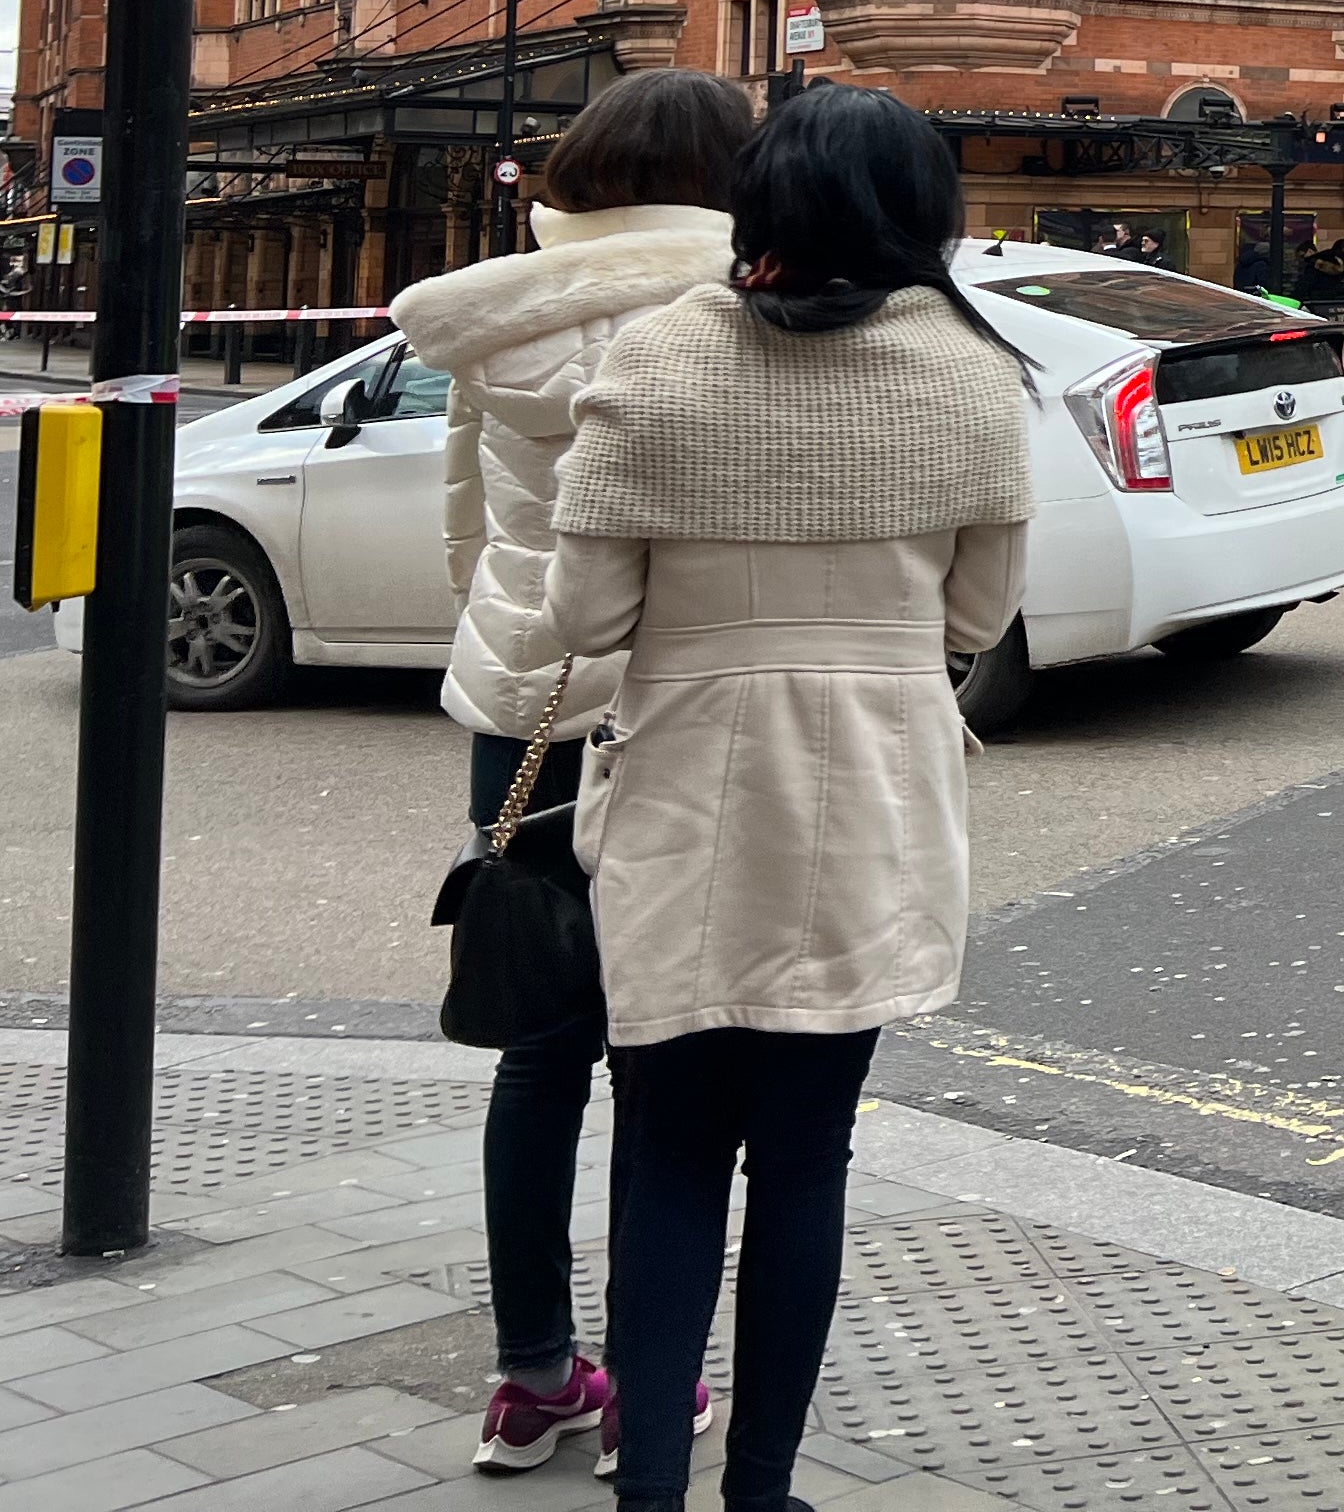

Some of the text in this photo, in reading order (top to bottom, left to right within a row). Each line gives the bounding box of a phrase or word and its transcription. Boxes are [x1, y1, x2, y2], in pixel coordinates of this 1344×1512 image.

[63, 147, 96, 156] ZONE
[1246, 430, 1315, 466] LW15 HCZ
